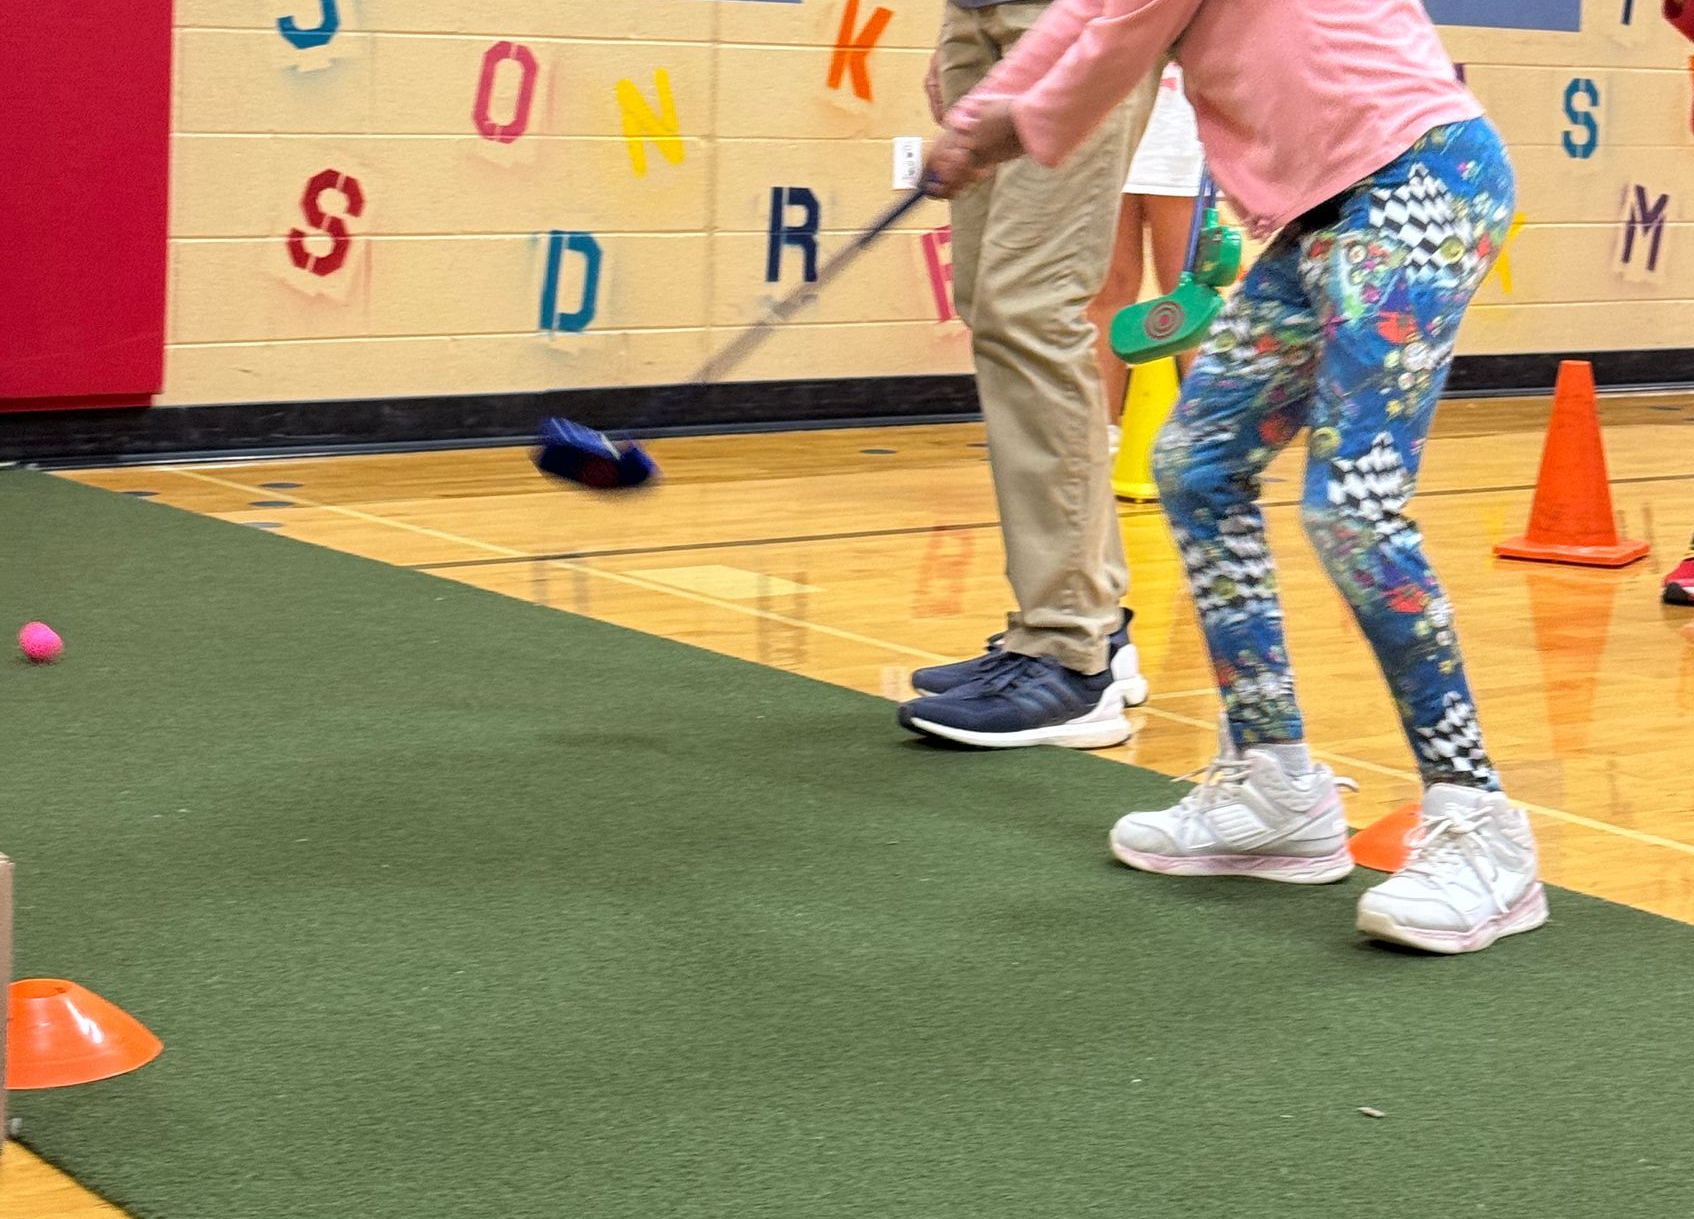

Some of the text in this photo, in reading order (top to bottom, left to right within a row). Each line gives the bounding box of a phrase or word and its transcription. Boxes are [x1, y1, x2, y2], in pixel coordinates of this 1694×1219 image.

[471, 40, 539, 144] O
[615, 68, 684, 178] N
[1562, 77, 1599, 160] S
[285, 169, 365, 277] S
[766, 186, 821, 283] R
[1621, 184, 1669, 272] M
[538, 229, 603, 334] D
